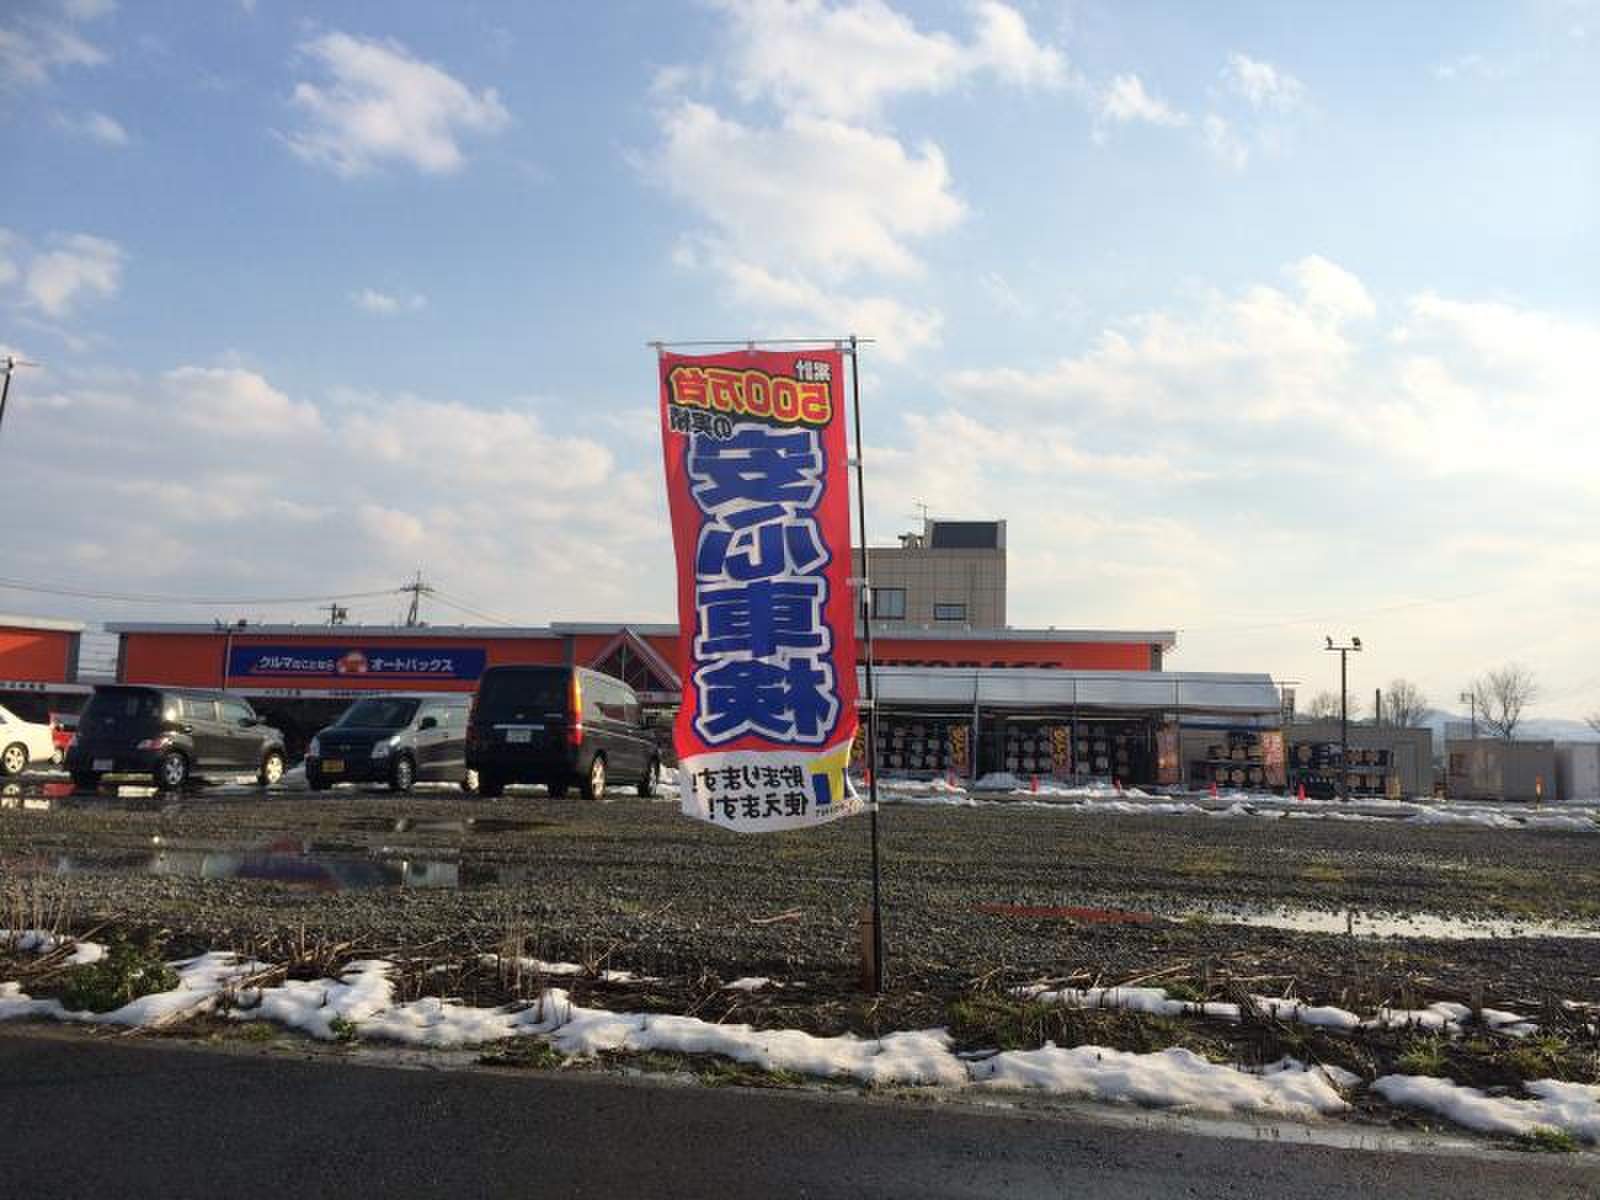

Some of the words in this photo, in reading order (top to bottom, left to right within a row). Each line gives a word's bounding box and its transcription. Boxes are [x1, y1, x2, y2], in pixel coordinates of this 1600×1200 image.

[371, 658, 454, 671] オートバックス
